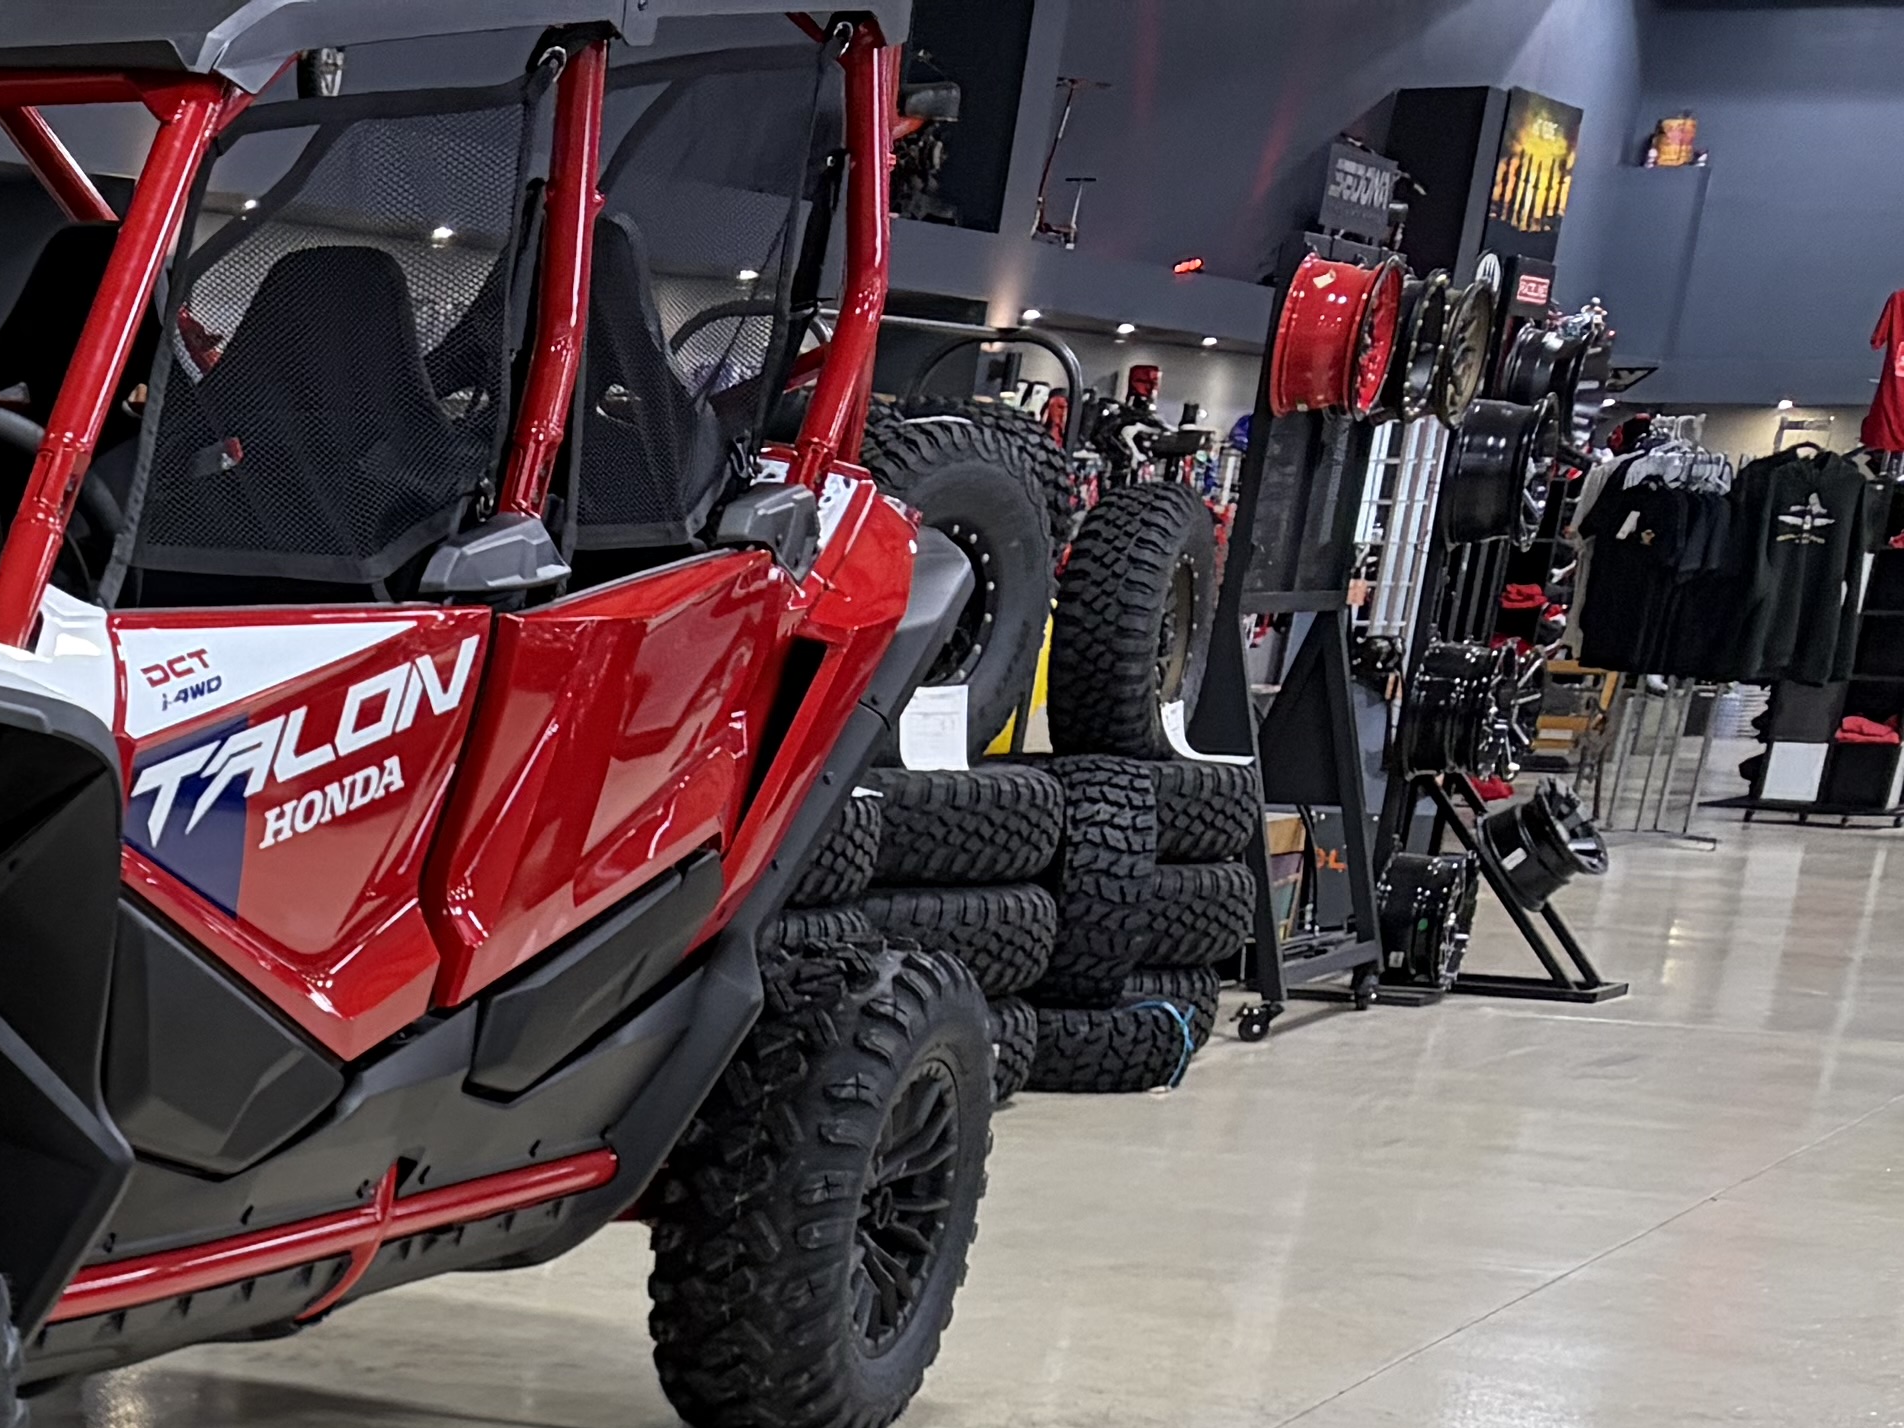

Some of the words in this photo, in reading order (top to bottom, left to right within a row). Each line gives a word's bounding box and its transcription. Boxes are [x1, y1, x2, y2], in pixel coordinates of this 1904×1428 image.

[140, 648, 210, 688] DCT
[131, 634, 480, 849] TALON
[258, 755, 405, 850] HONDA
